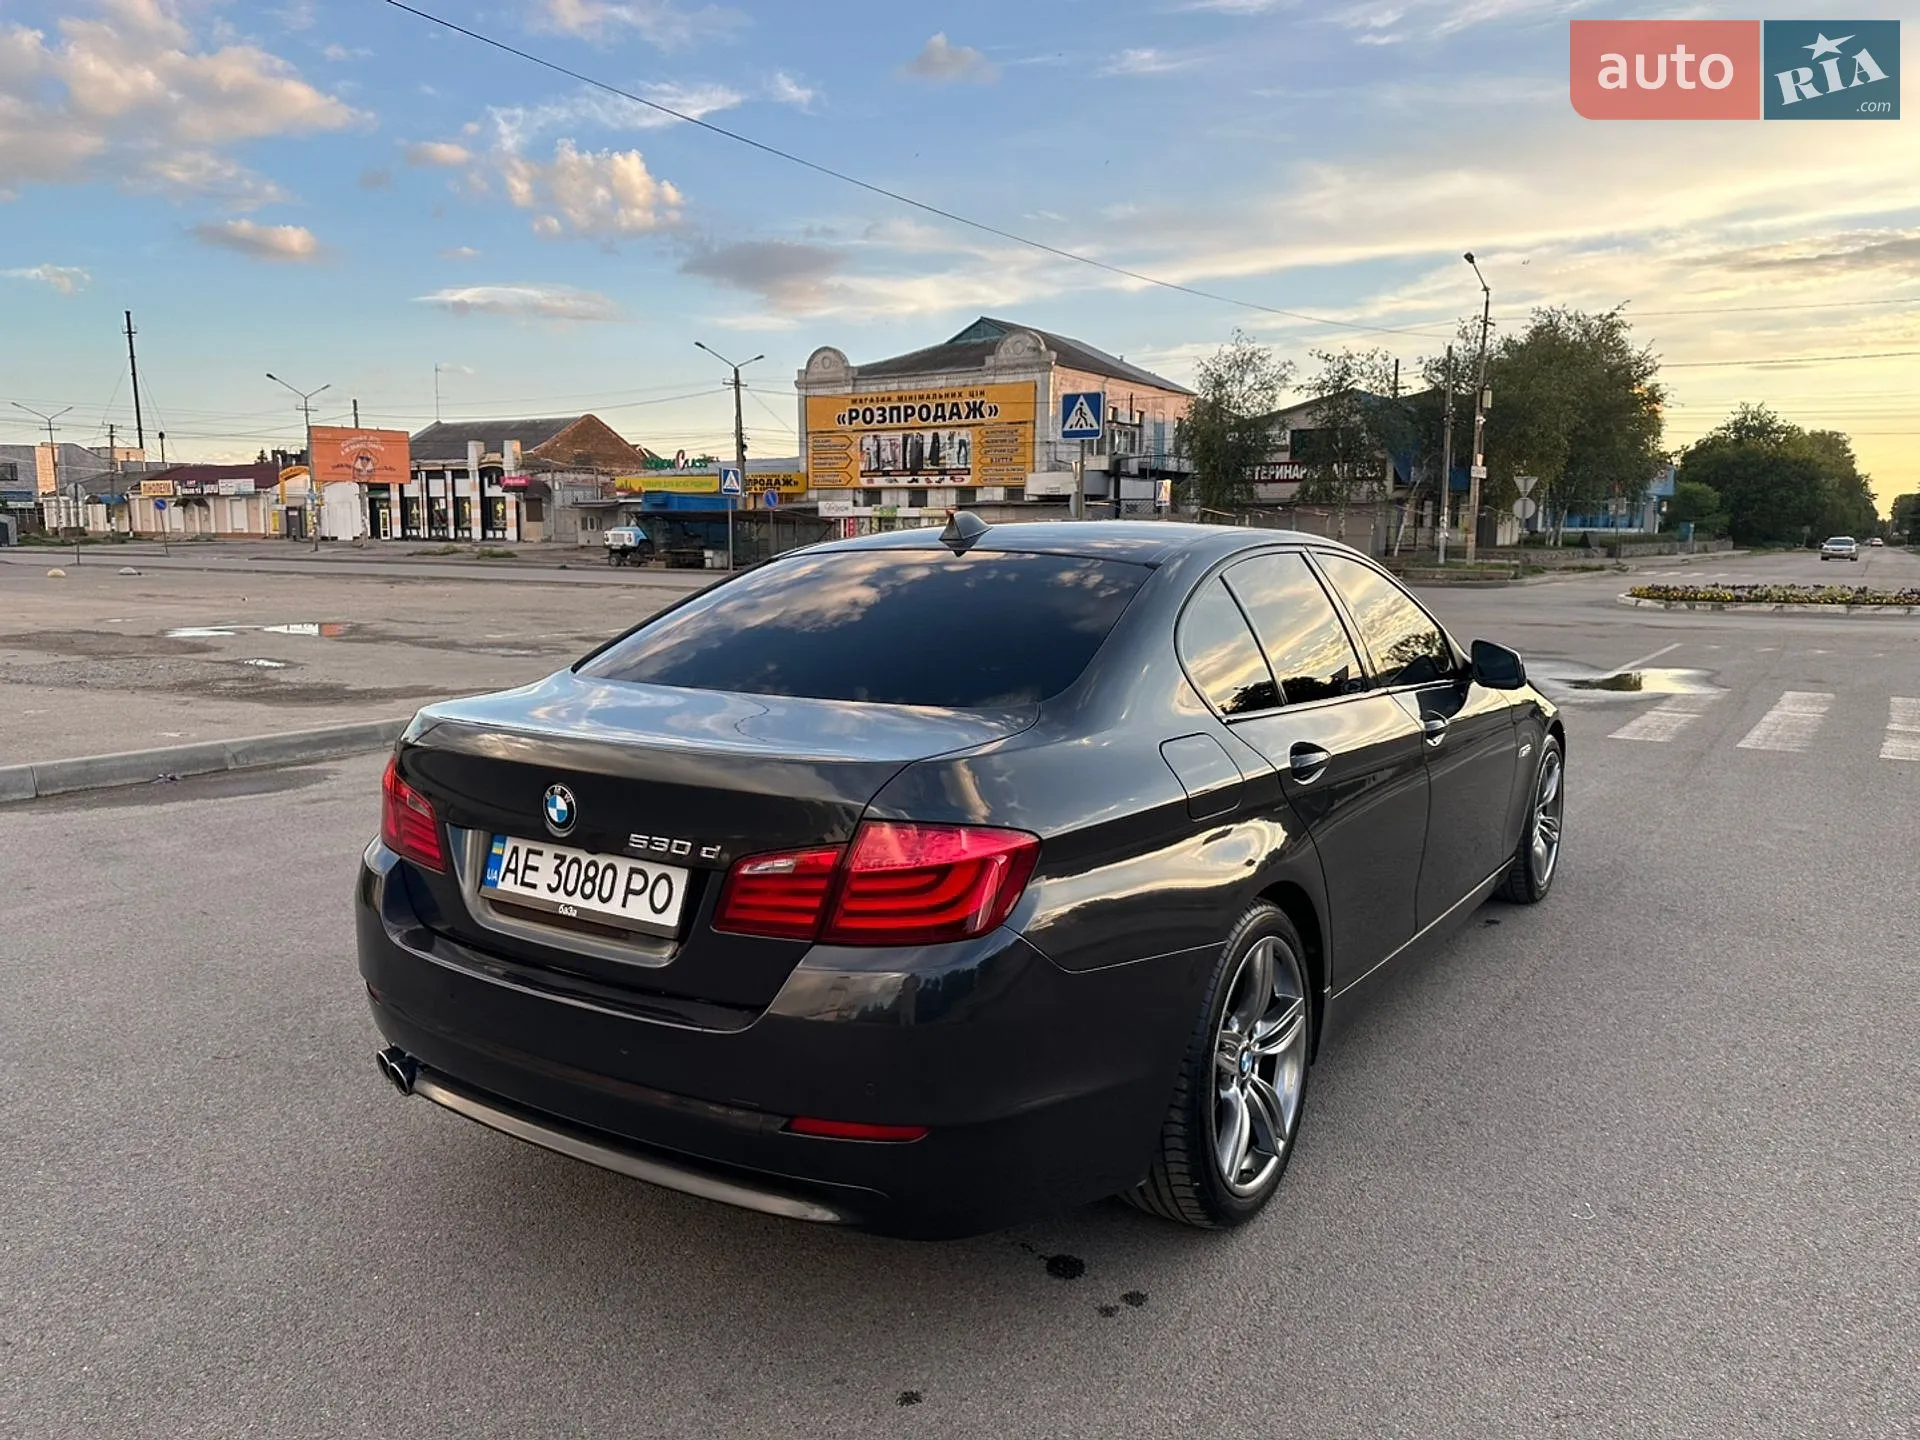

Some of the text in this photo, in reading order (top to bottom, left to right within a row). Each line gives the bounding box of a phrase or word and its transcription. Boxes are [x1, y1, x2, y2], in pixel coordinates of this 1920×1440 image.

[851, 389, 986, 405] МАГАЗИН МІНІМАЛЬНИХ ЦІН
[837, 400, 999, 425] «РОЗПРОДАЖ»
[629, 833, 721, 859] 530 d
[487, 868, 498, 881] UA
[501, 845, 674, 915] AE 3080 PO
